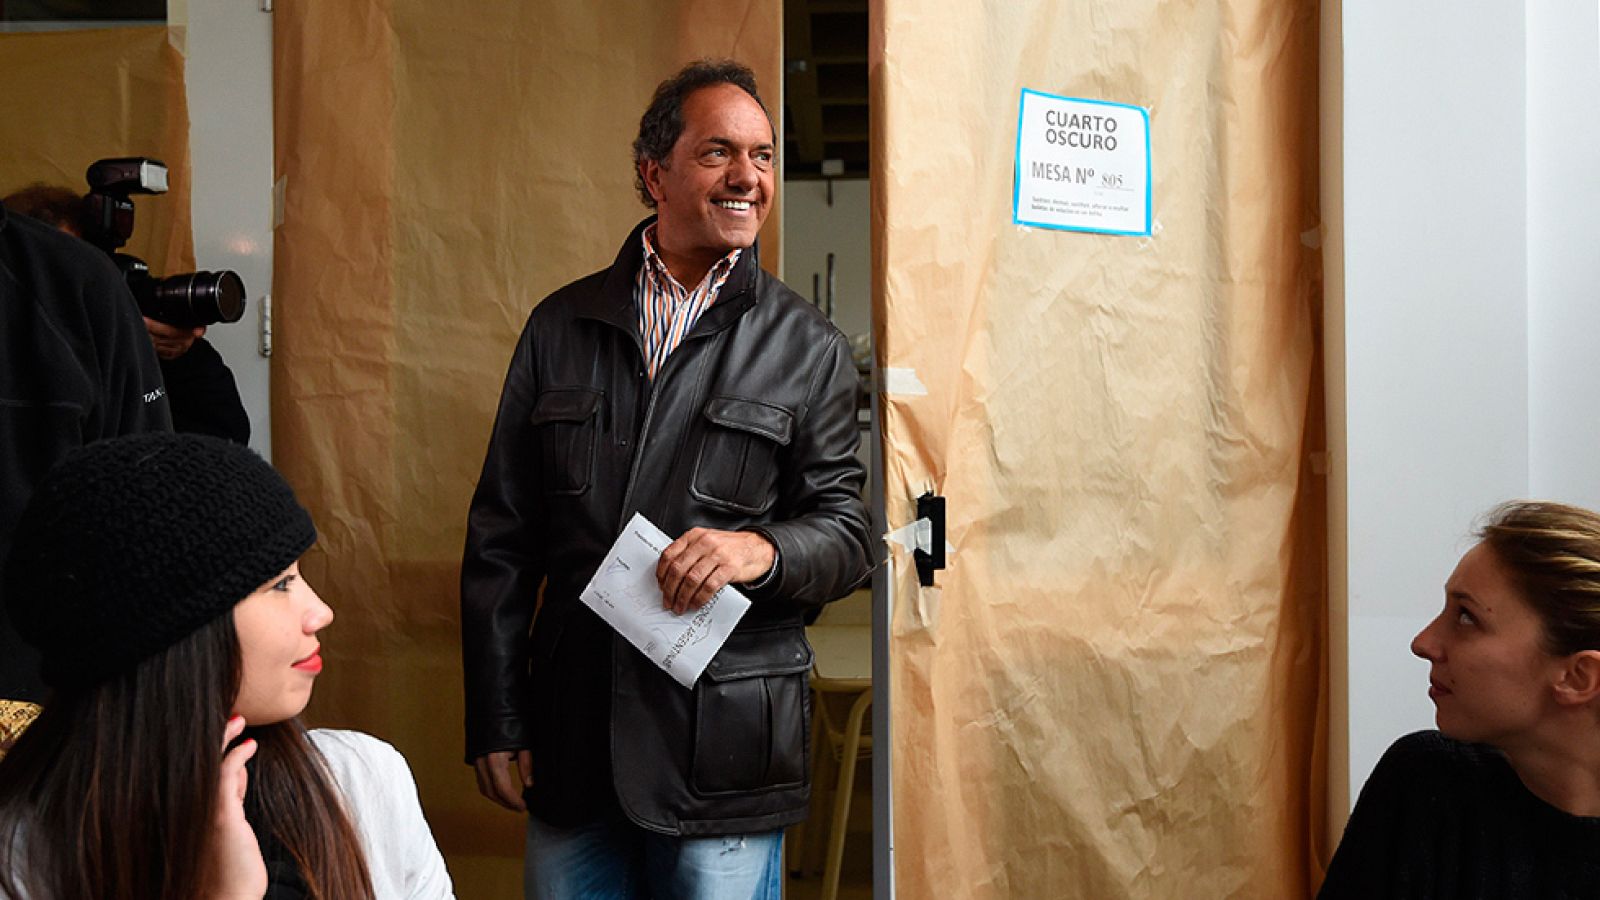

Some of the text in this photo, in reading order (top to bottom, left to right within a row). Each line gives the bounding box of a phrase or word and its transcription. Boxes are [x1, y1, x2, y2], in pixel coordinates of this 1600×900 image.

[1046, 110, 1117, 132] CUARTO
[1046, 128, 1117, 151] OSCURO
[1031, 161, 1072, 183] MESA
[1101, 173, 1122, 188] 805
